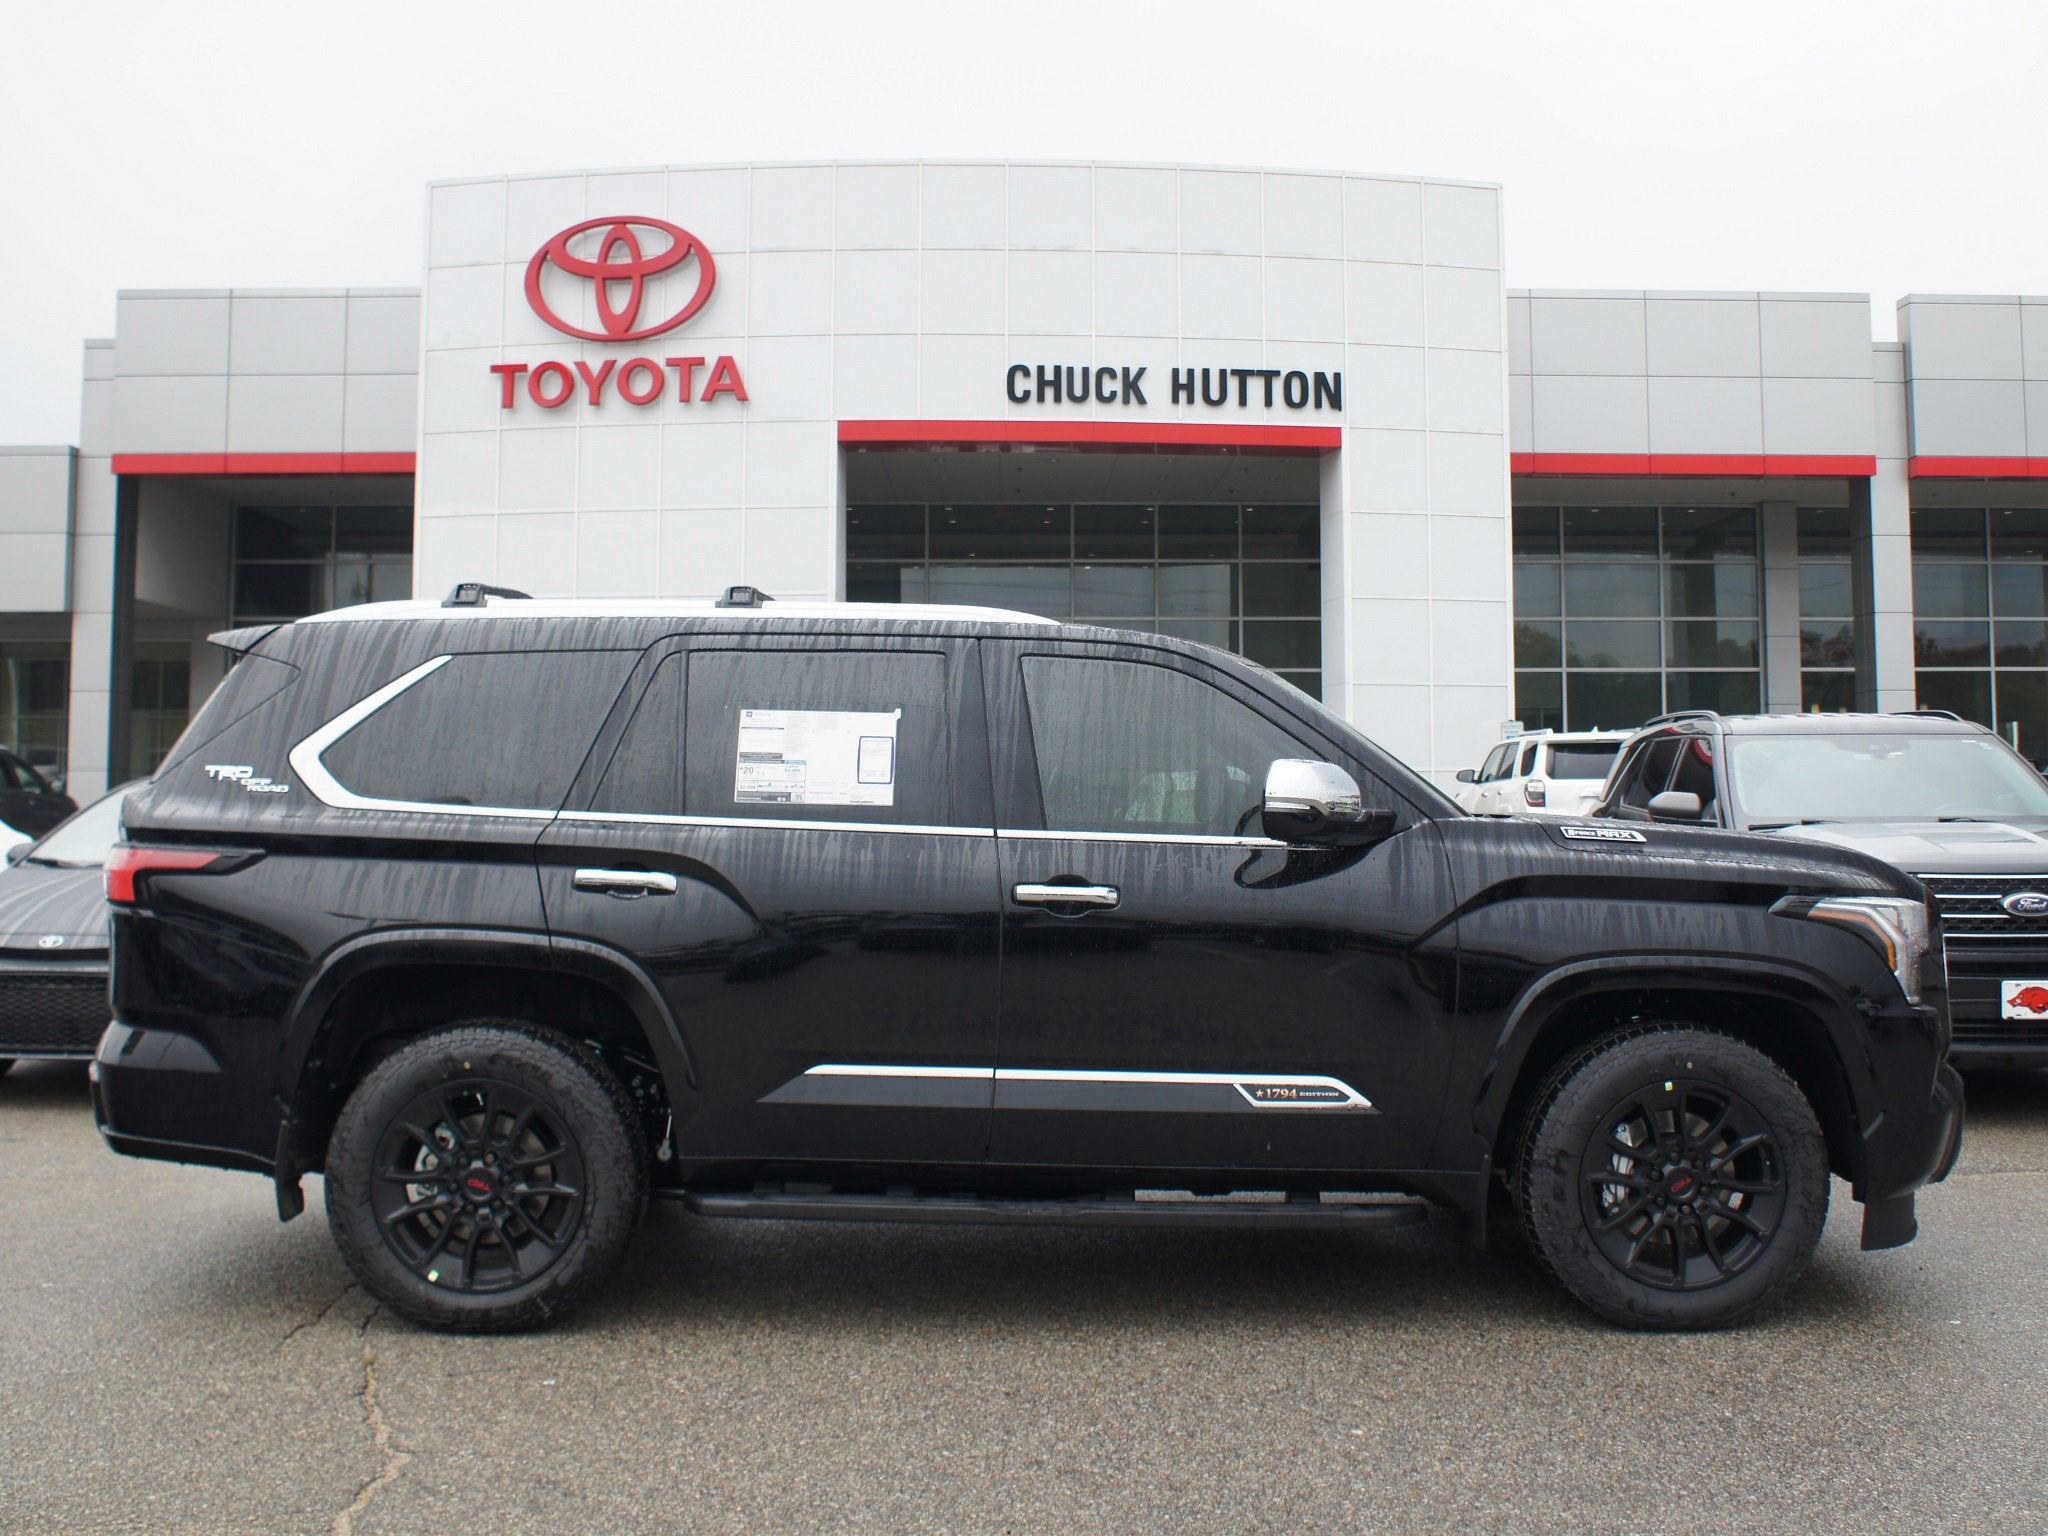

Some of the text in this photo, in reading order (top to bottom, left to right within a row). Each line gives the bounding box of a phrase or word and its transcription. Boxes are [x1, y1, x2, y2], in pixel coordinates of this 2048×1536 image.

[490, 355, 749, 409] TOYOTA
[1006, 364, 1343, 412] CHUCK HUTTON
[204, 765, 253, 781] TRD
[246, 785, 289, 793] ROAD
[1596, 829, 1632, 839] MAX
[2018, 898, 2047, 911] Ford
[1265, 1088, 1297, 1099] 1794
